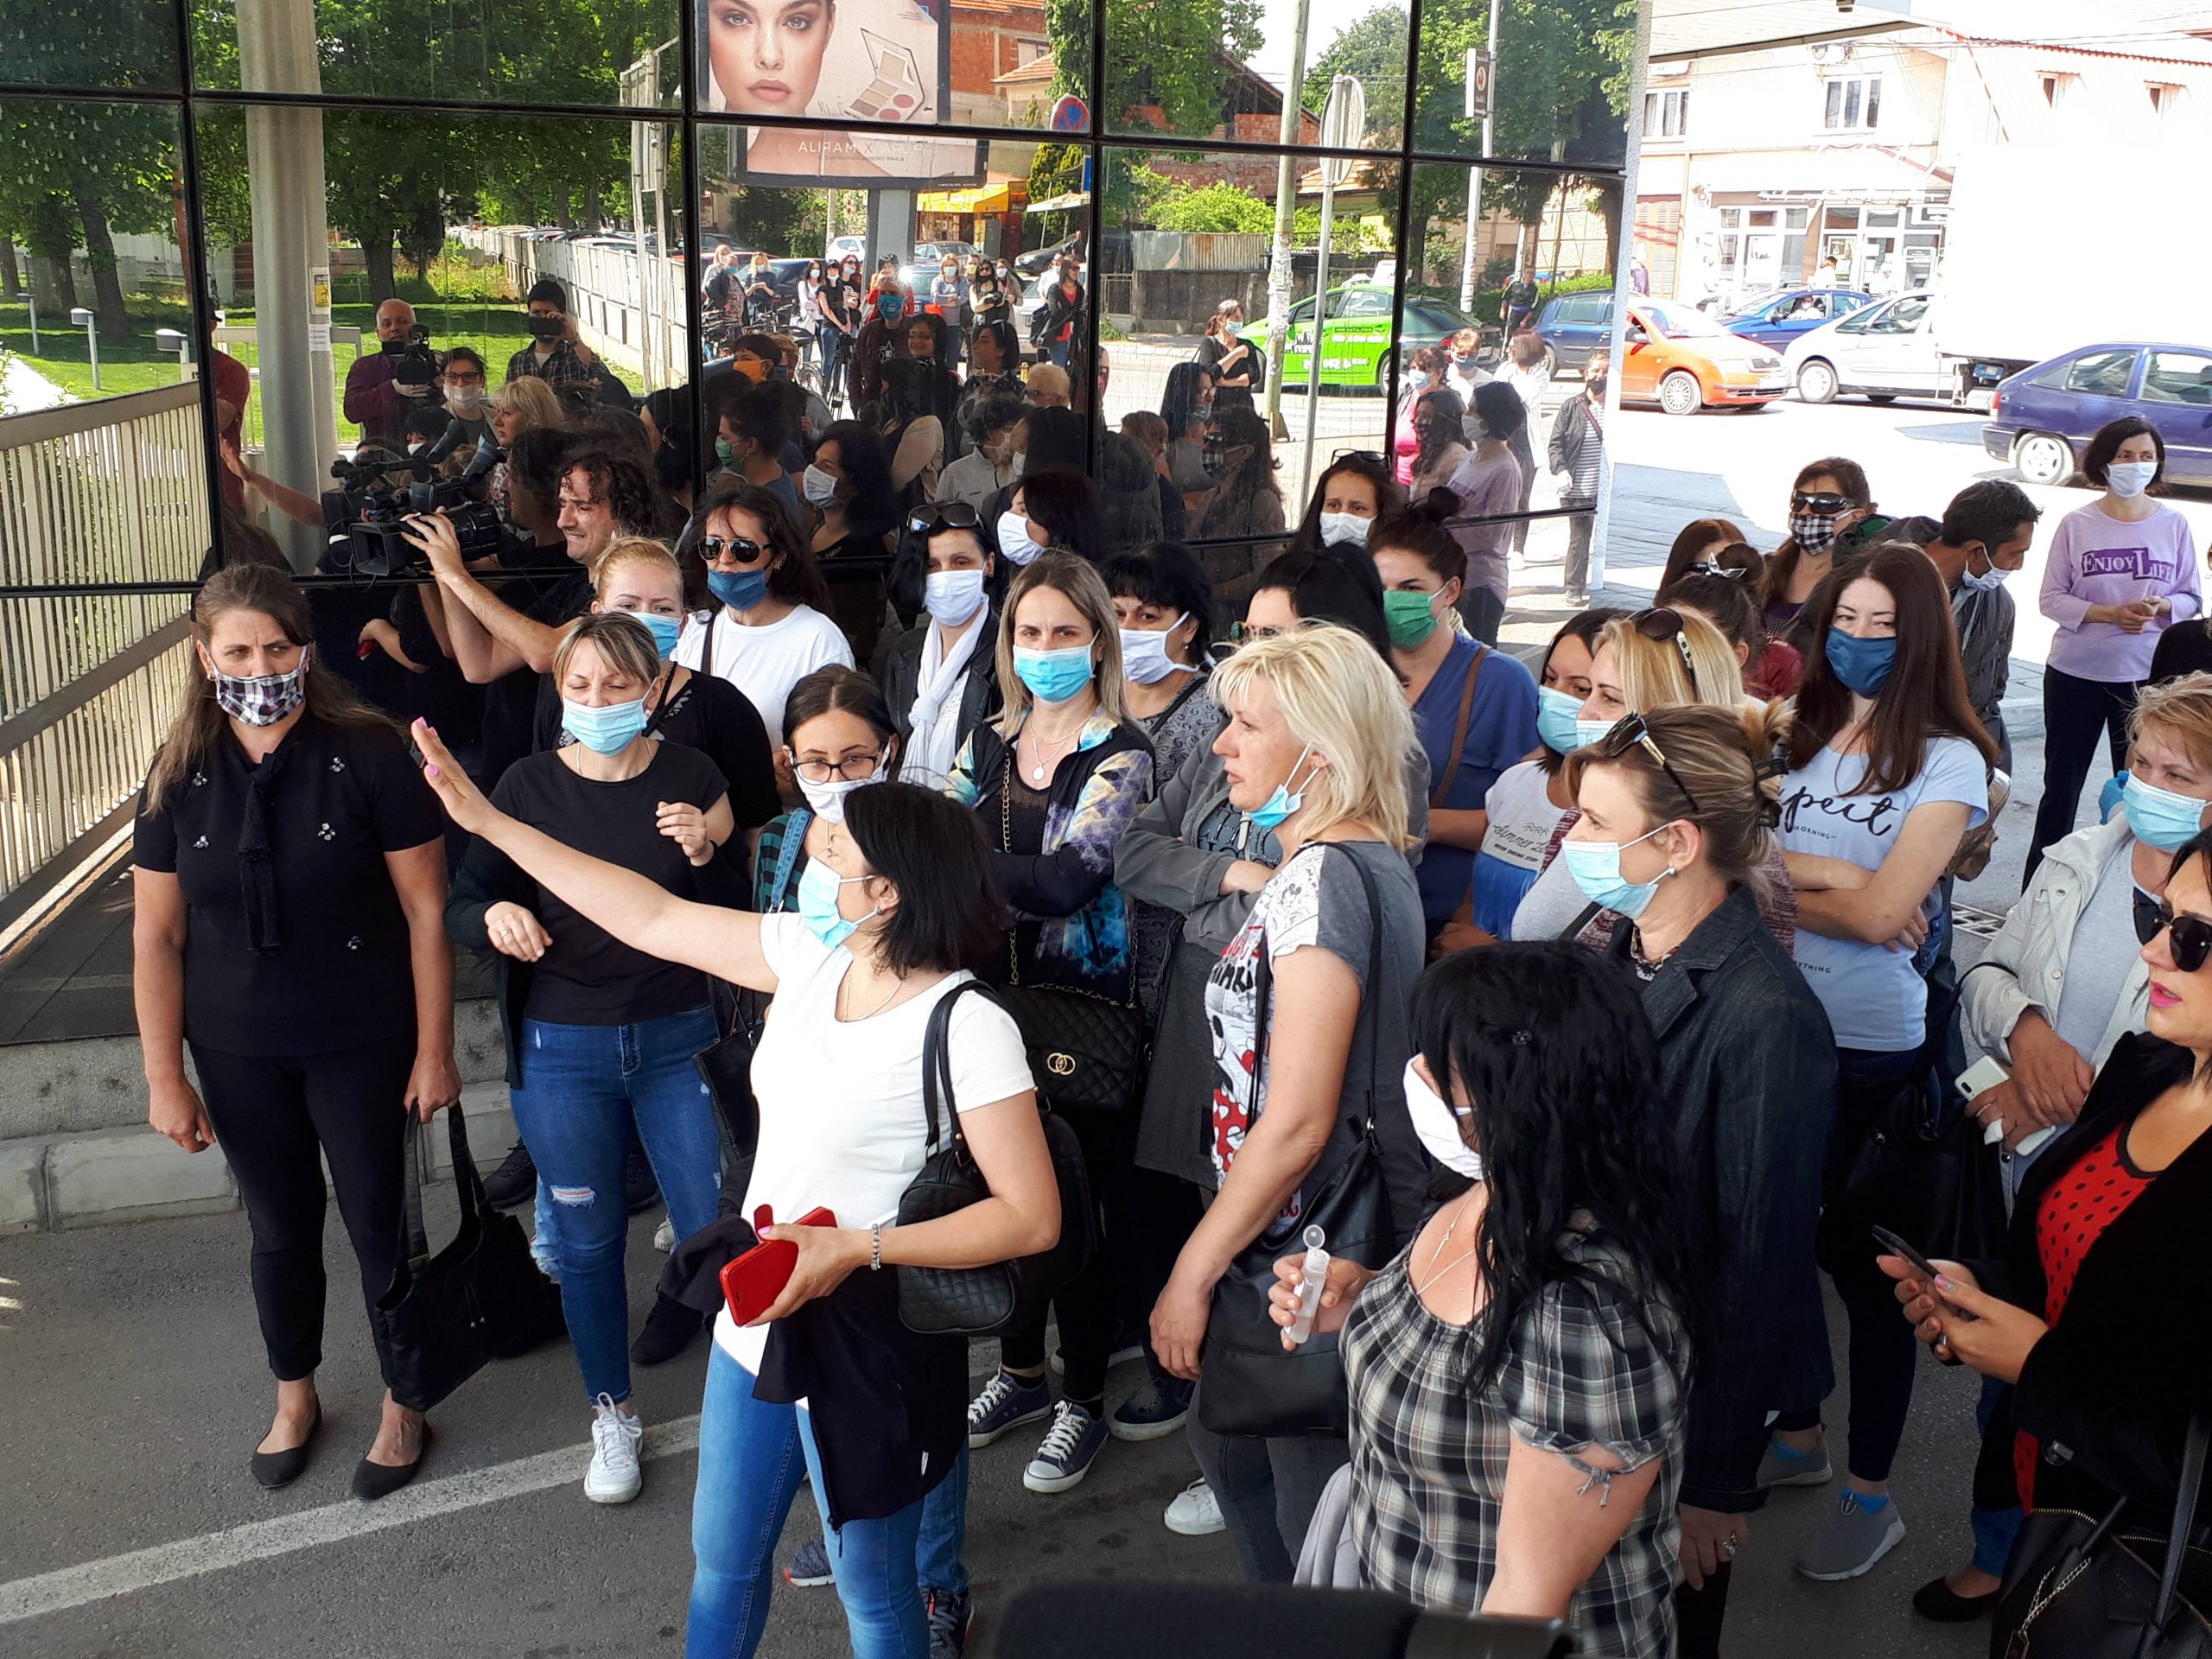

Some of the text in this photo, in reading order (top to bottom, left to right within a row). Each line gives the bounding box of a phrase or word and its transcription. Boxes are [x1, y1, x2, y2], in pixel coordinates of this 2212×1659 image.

[2083, 550, 2172, 582] ENJOY LIFE
[1778, 785, 1900, 836] pect
